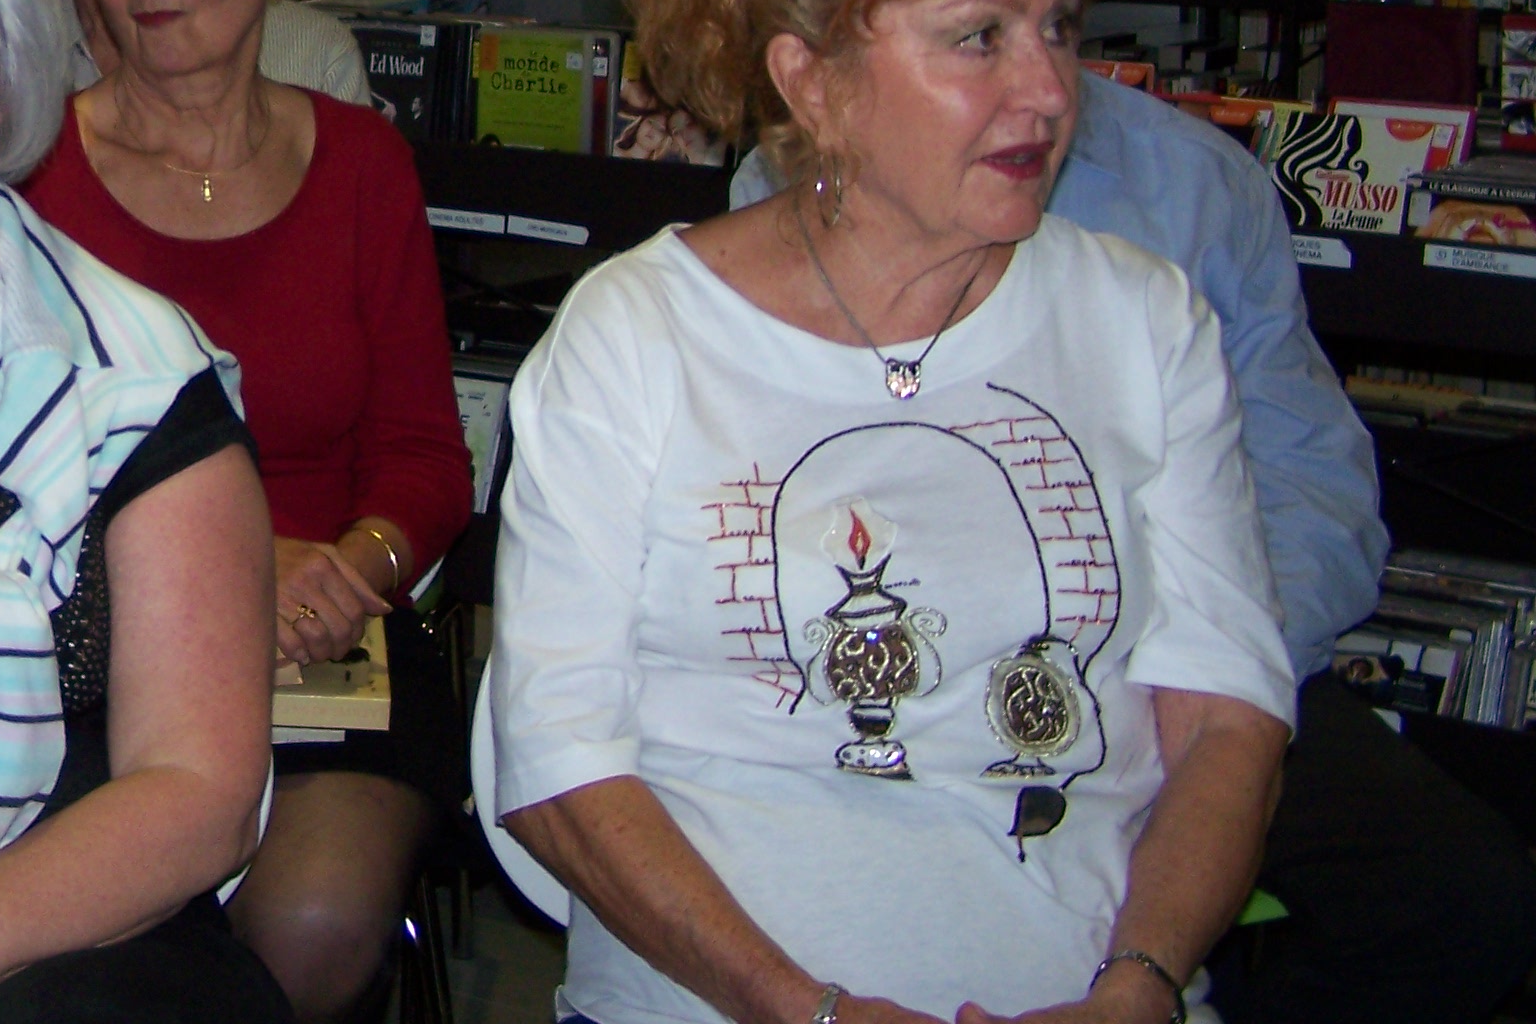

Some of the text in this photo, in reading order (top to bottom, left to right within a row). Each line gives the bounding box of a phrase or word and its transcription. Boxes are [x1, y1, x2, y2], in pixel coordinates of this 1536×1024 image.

[370, 52, 425, 77] Ed Wood
[503, 55, 560, 72] monde
[490, 71, 569, 94] Charlie
[1321, 179, 1399, 213] MUSSO
[1344, 209, 1384, 230] Jeune
